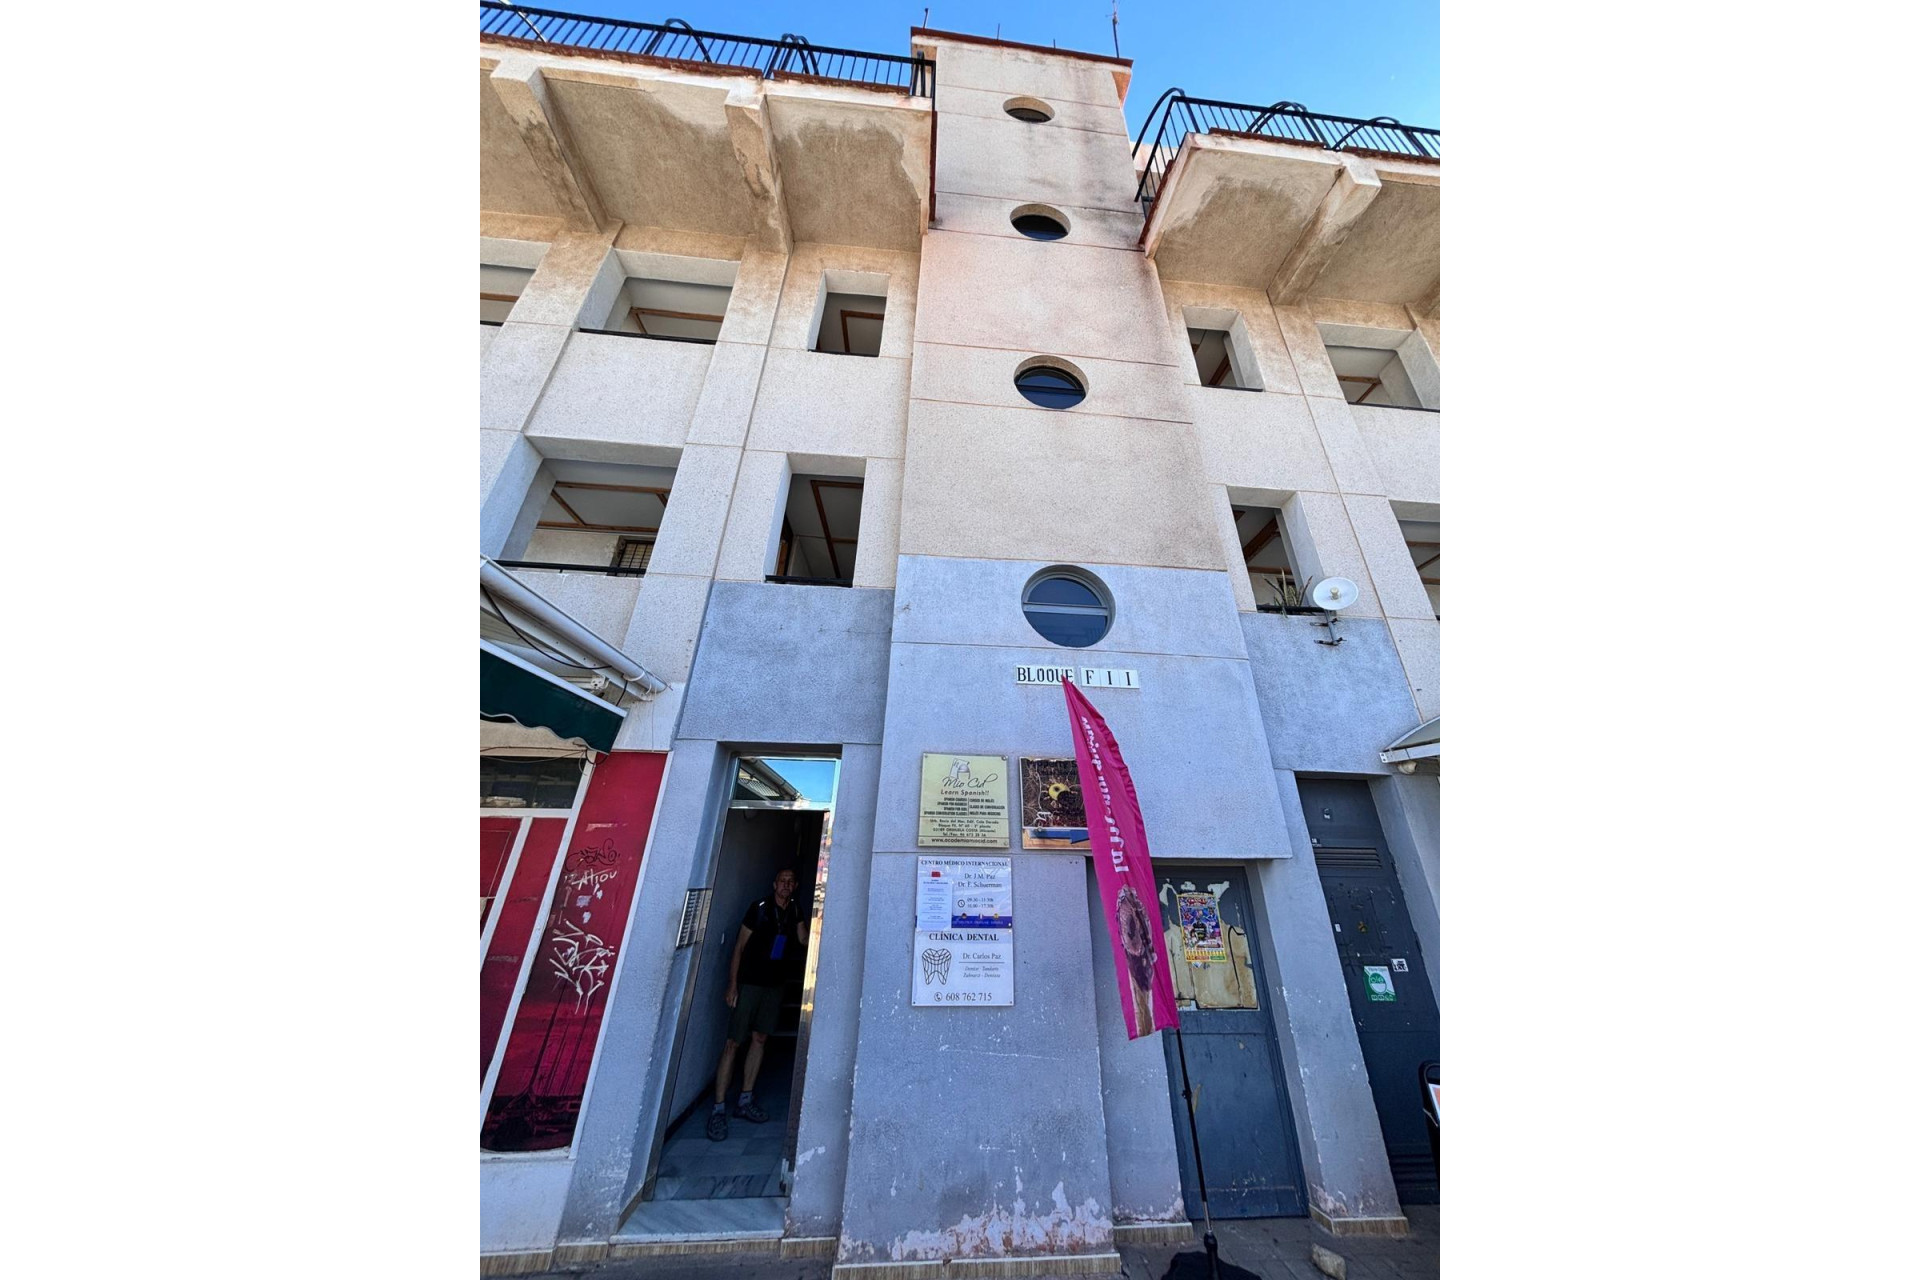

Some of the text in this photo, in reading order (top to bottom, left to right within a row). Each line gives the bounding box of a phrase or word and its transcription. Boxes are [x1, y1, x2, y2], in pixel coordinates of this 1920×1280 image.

[942, 773, 998, 788] Mio Cid
[928, 931, 999, 941] CLÍNICA DENTAL
[962, 952, 1002, 960] Dr. Carlos Paz
[945, 992, 992, 1002] 608 762 715
